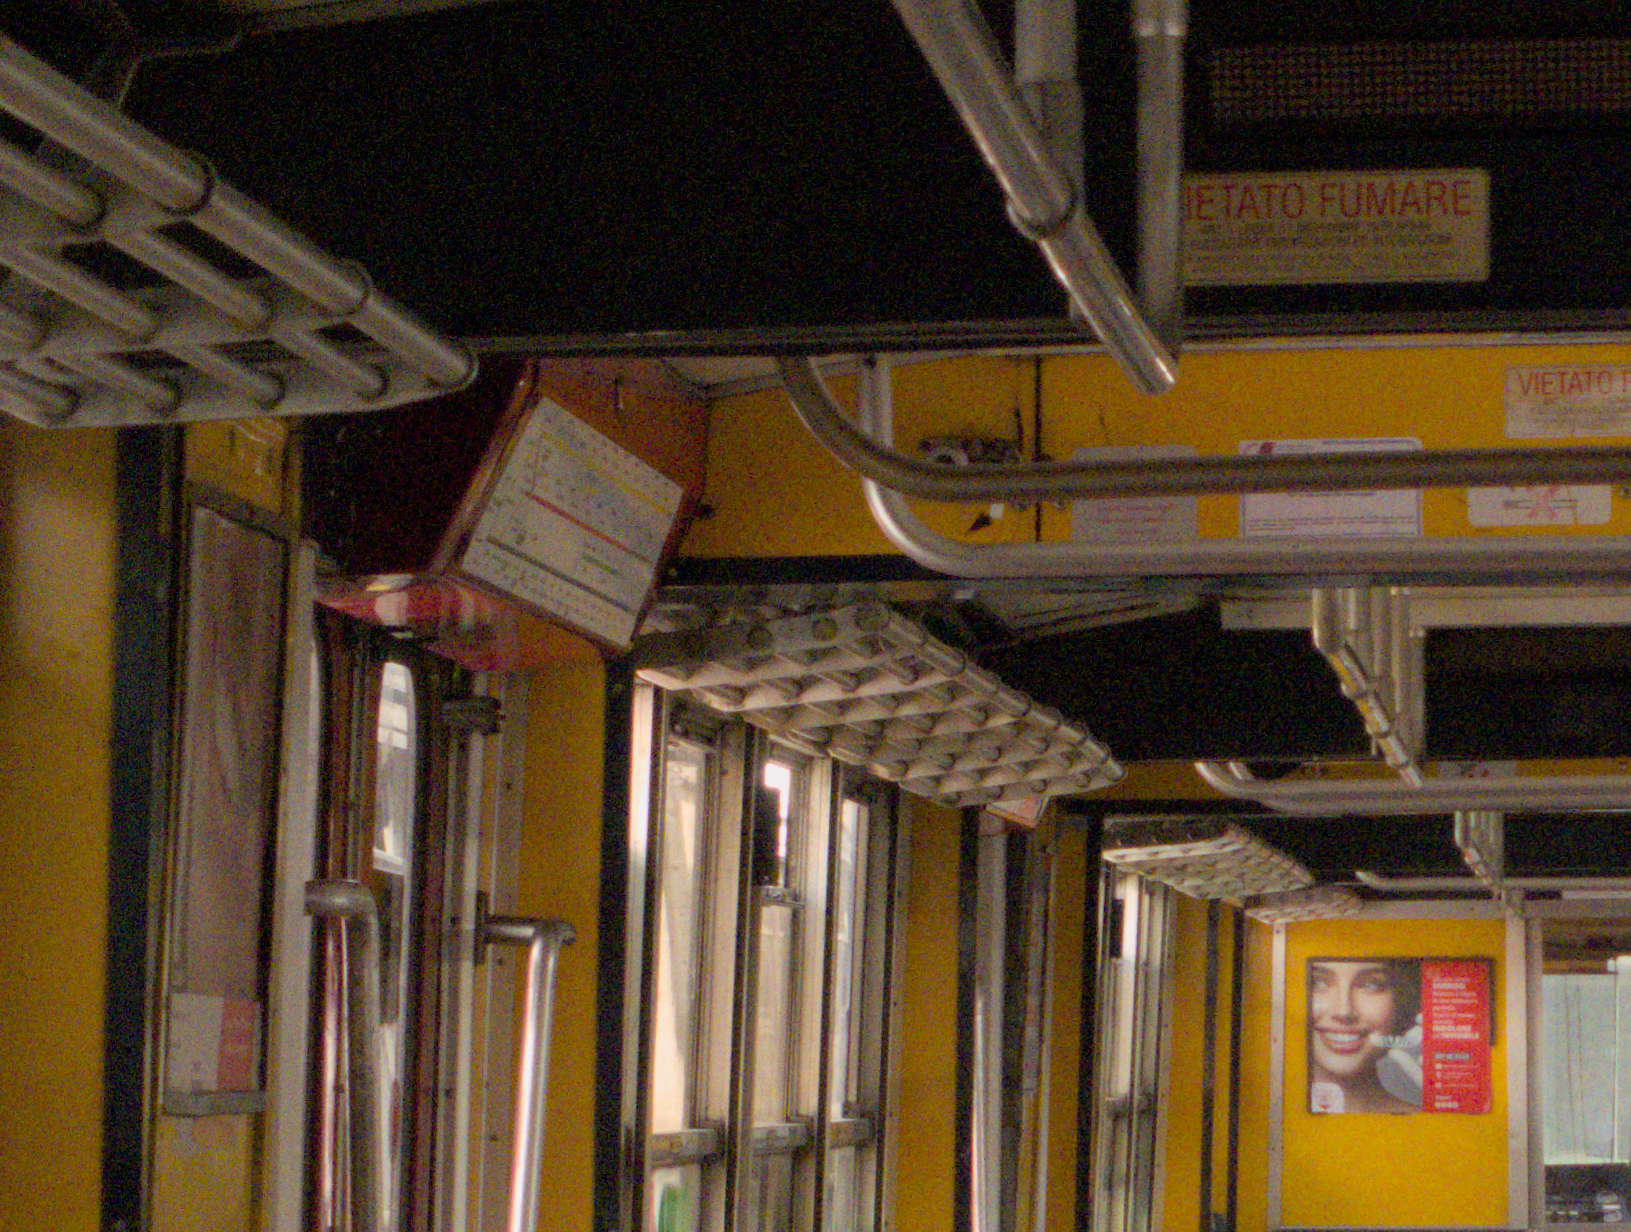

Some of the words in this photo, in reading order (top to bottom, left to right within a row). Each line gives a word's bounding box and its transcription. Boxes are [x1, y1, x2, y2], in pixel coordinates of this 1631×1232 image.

[1183, 182, 1304, 220] IETATO
[1320, 179, 1472, 218] FUMARE
[1515, 368, 1613, 396] VIETATO
